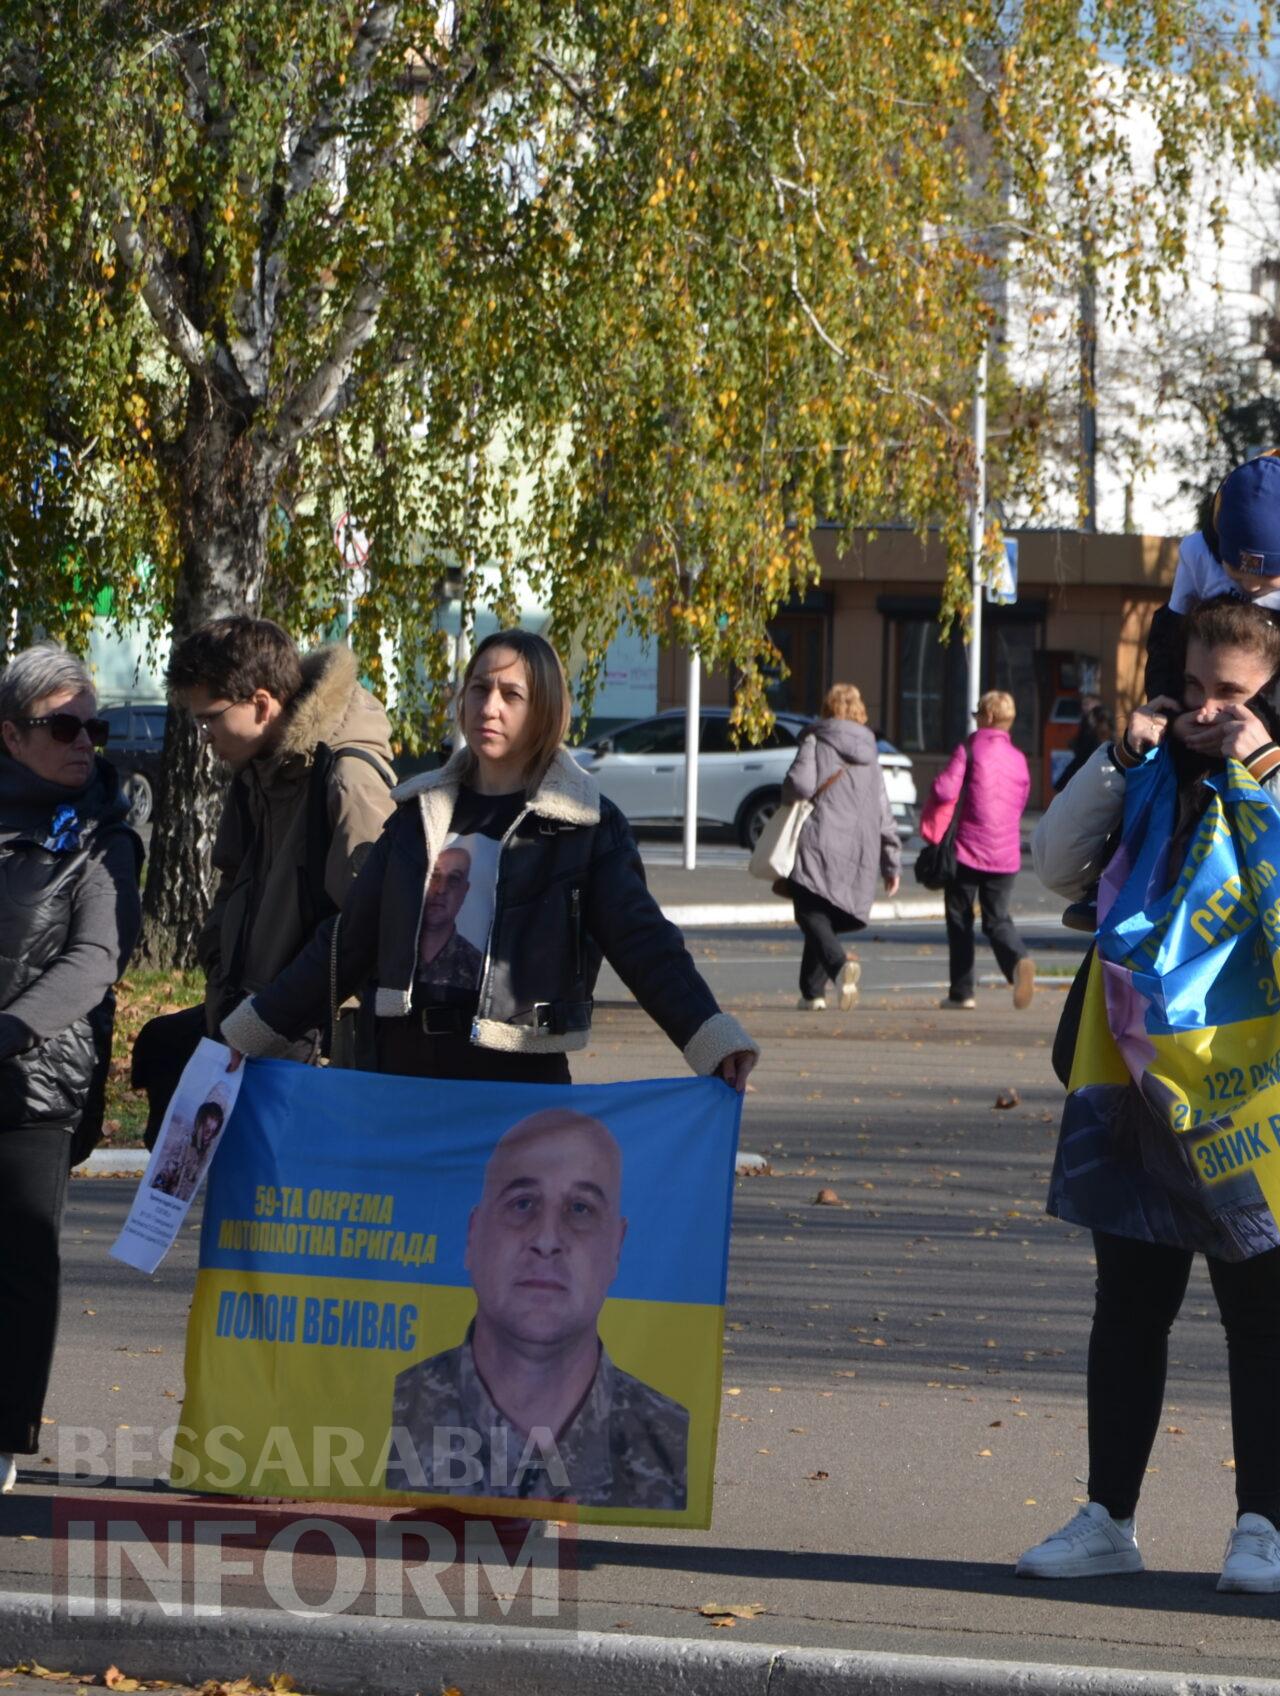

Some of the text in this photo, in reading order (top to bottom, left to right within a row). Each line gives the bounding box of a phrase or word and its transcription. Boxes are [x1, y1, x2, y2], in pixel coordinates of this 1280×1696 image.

[1197, 1123, 1271, 1179] ЗНИК
[254, 1185, 395, 1225] 59-ТА ОКРЕМА
[217, 1219, 336, 1257] МОТОПІХОТНА
[340, 1227, 438, 1268] БРИГАДА
[215, 1290, 419, 1352] ПОЛОН ВБИВАЄ
